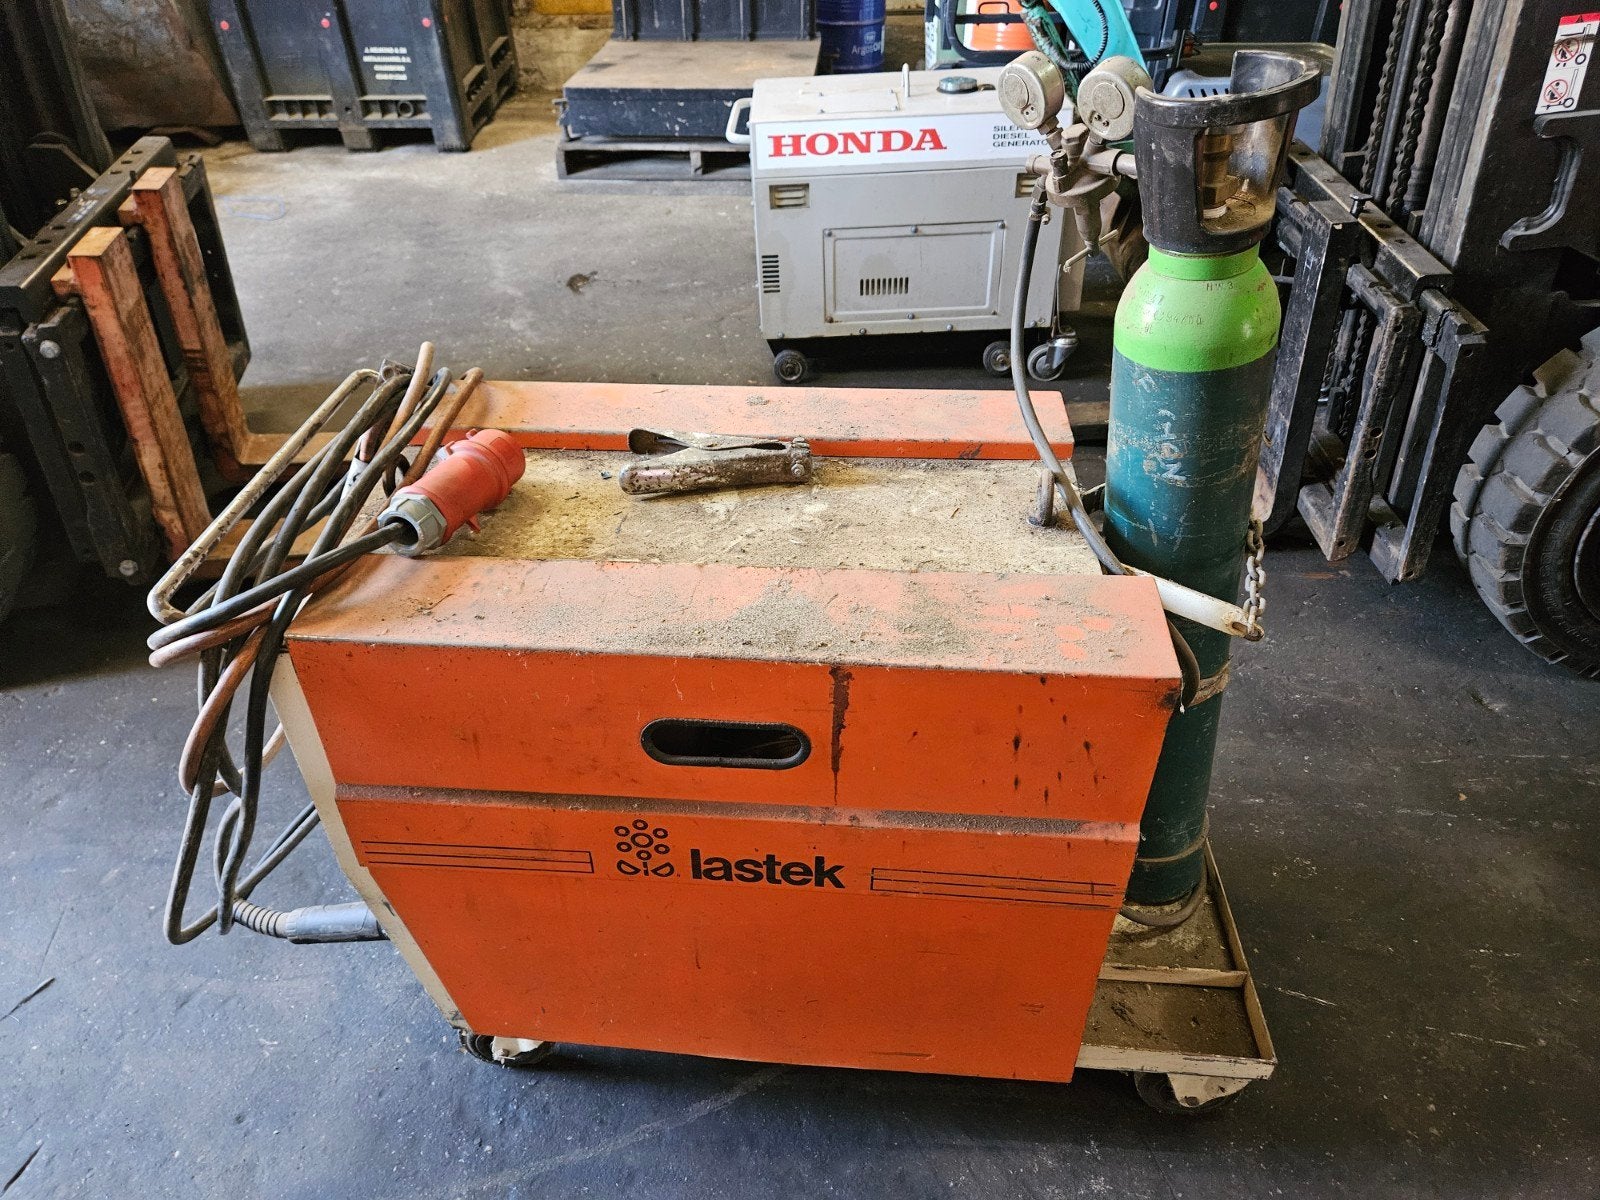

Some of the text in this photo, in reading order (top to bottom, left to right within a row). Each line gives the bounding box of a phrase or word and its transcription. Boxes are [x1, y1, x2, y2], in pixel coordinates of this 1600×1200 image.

[767, 128, 947, 158] HONDA
[993, 132, 1030, 140] DIESEL
[993, 139, 1048, 148] GENERATO
[690, 848, 846, 889] lastek
